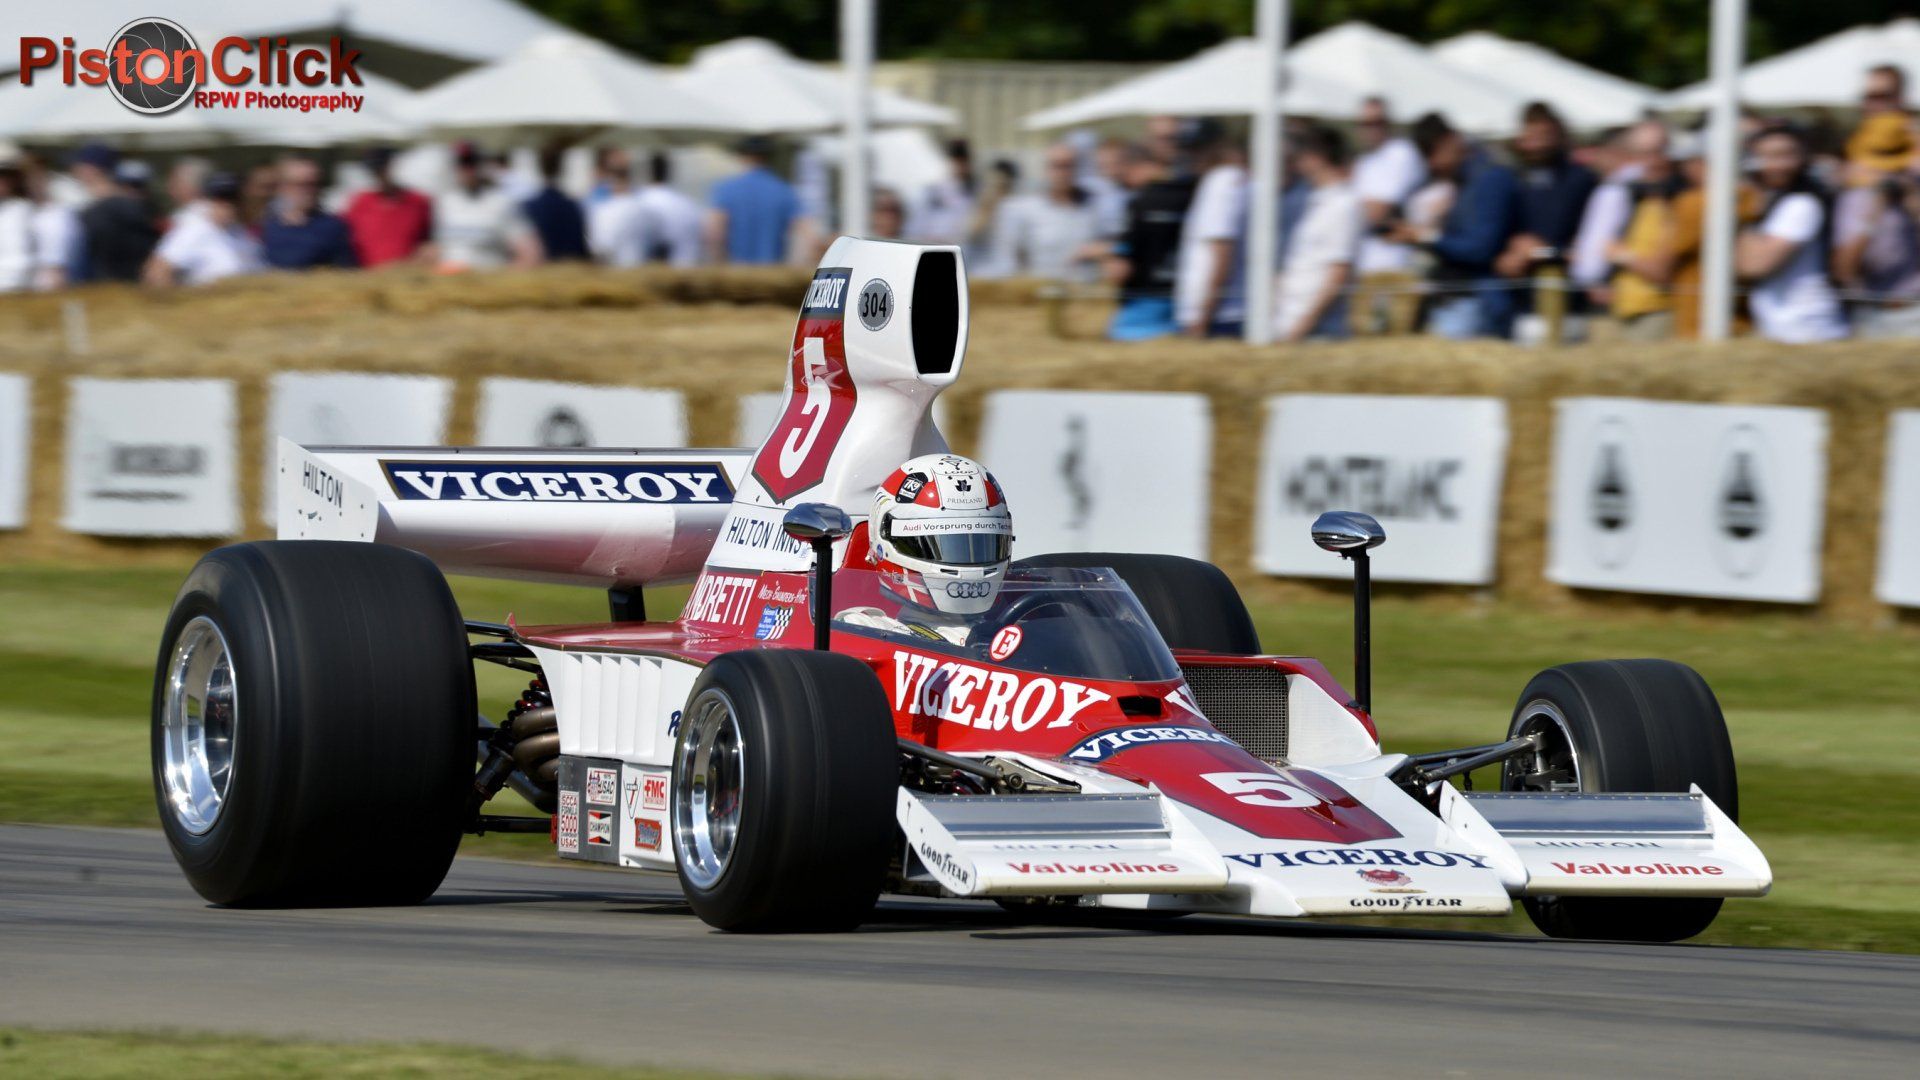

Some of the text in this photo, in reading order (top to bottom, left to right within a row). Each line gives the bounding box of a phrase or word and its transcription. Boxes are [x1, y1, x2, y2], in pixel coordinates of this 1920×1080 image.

[862, 292, 887, 318] 304
[778, 337, 832, 479] 5
[303, 460, 343, 509] HILTON
[394, 470, 720, 501] VICEROY
[726, 516, 802, 555] HILTON INNS
[903, 524, 922, 532] Audi
[924, 522, 973, 532] Vorsprung
[975, 522, 997, 531] durch
[993, 629, 1018, 656] E
[893, 650, 1112, 733] VICEROY
[1199, 771, 1322, 808] 5
[561, 814, 577, 833] 5000
[589, 821, 610, 834] CHAMPION
[560, 838, 577, 849] USAC
[1006, 861, 1180, 874] Valvoline
[1223, 848, 1496, 870] VICEROY
[1550, 861, 1724, 876] Valvoline
